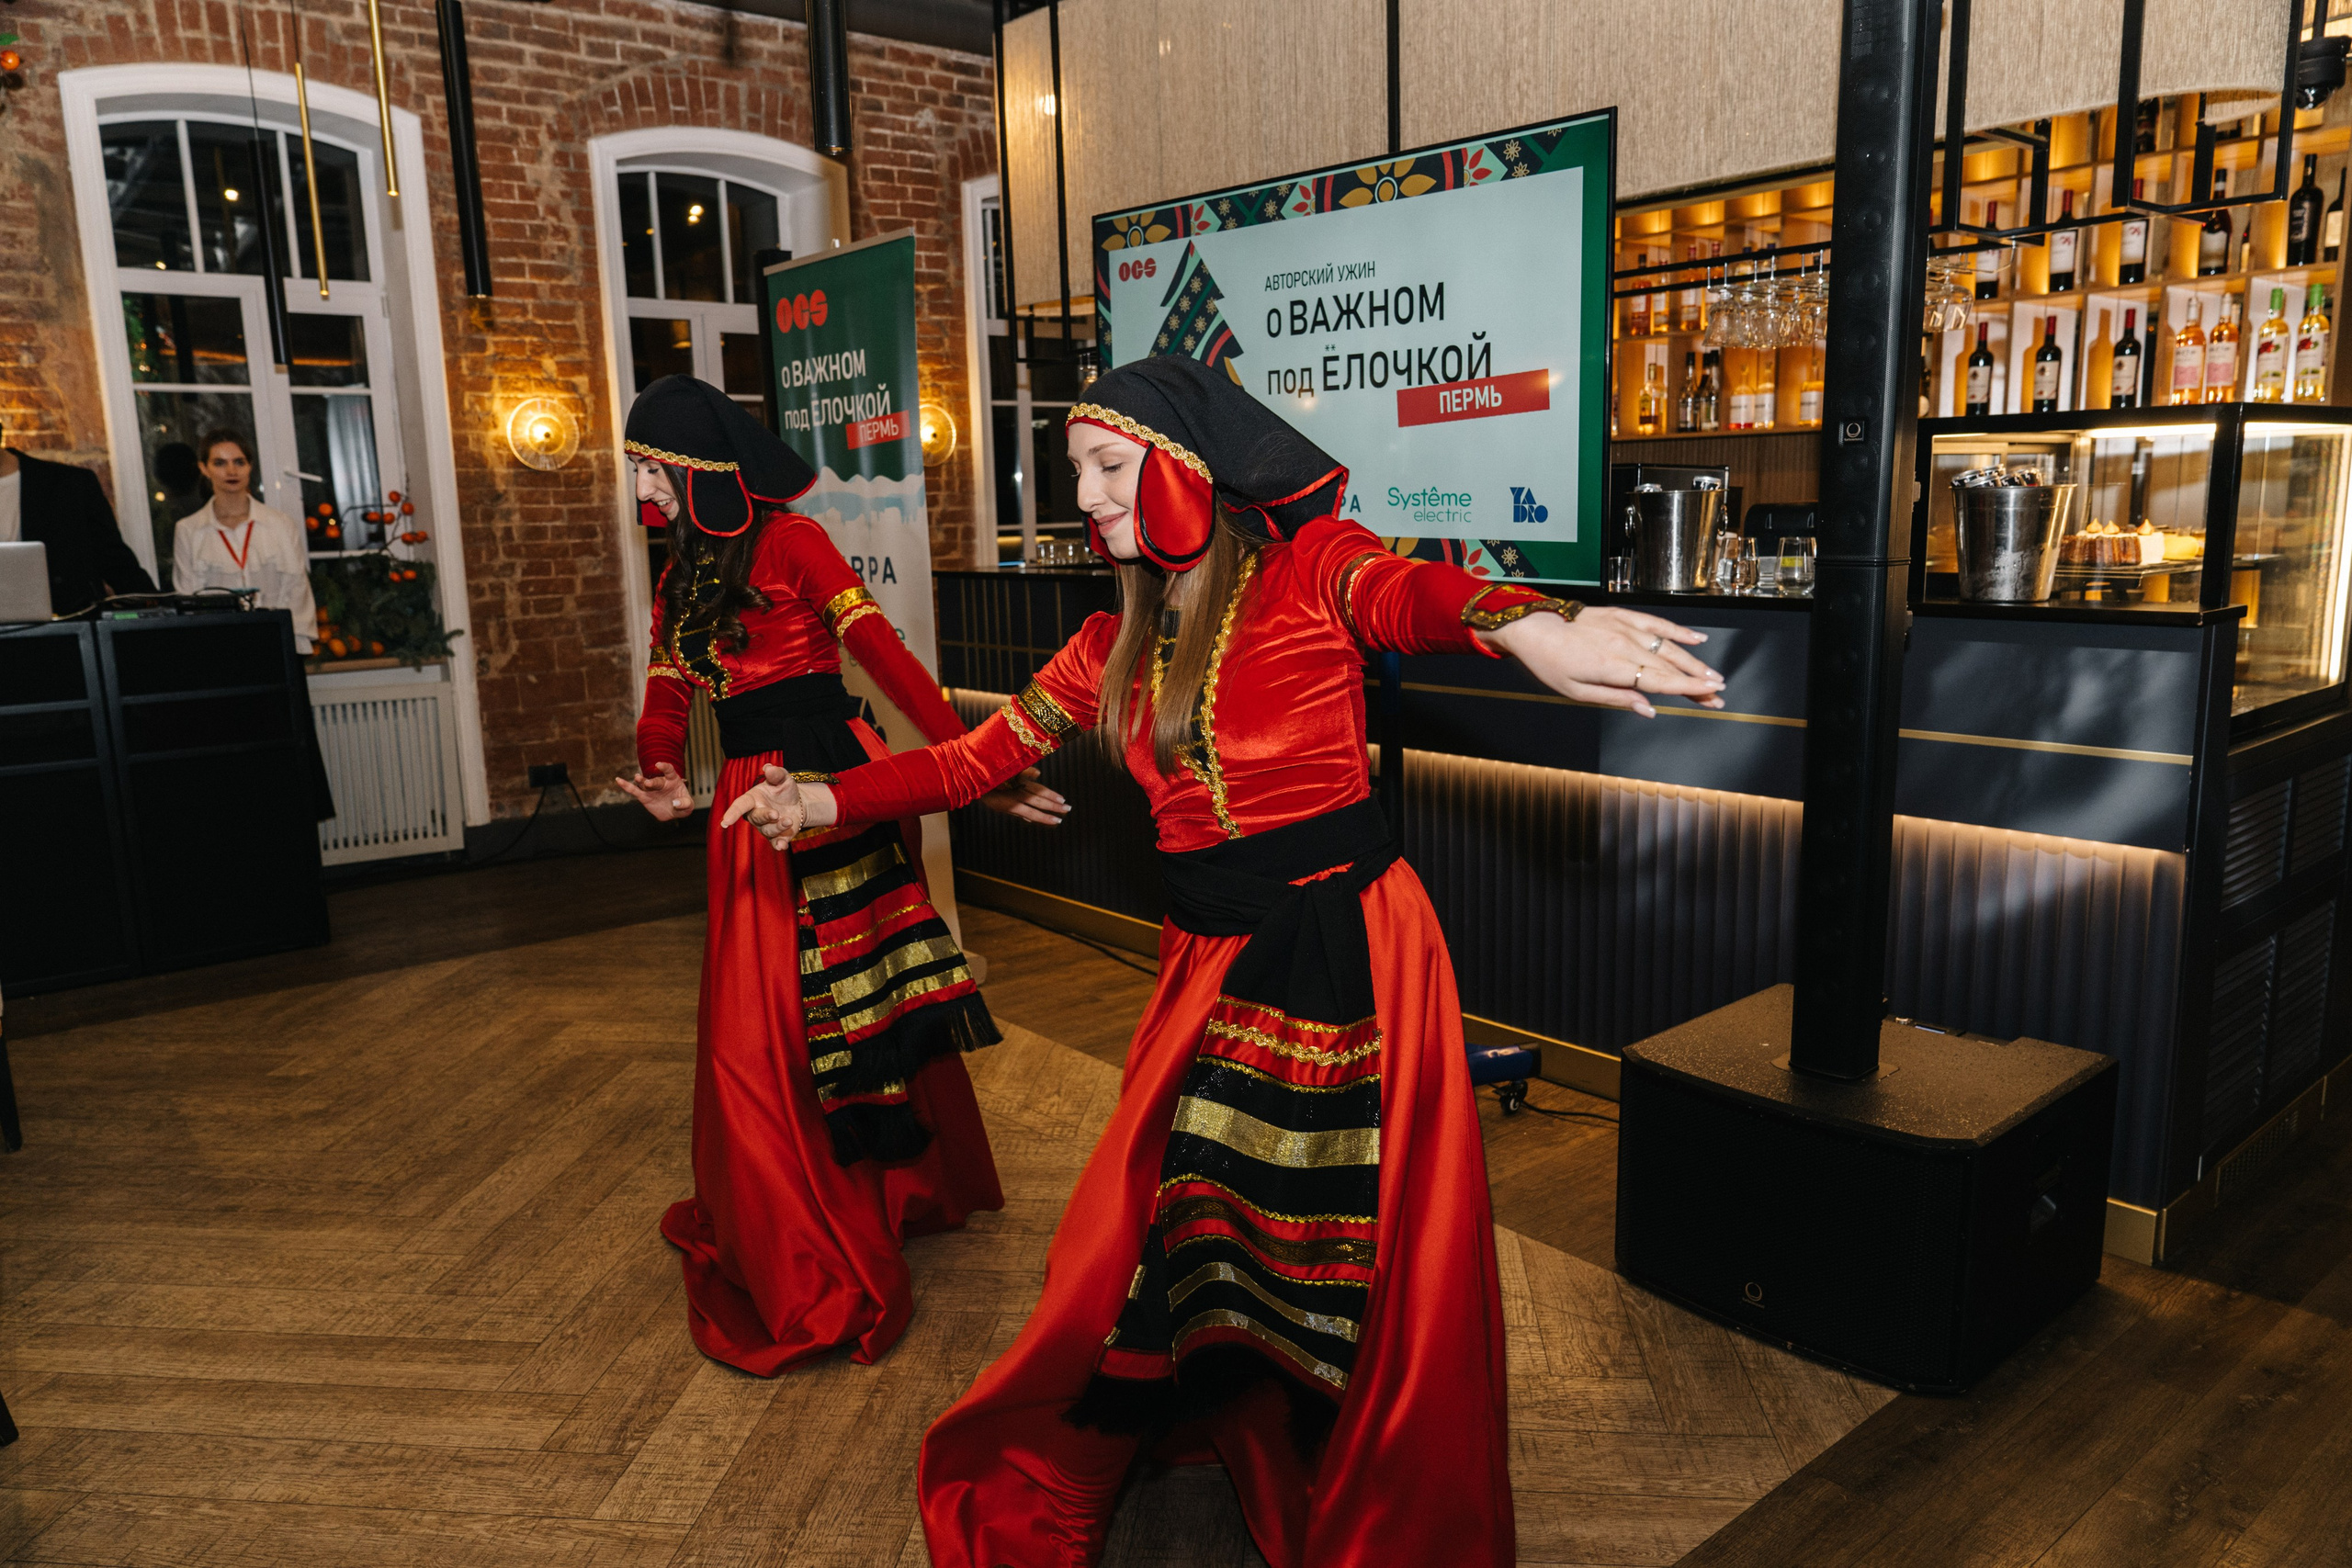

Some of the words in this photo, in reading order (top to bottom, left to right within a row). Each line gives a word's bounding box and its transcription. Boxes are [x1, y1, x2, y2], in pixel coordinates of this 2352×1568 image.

[1118, 257, 1157, 282] OCS
[1264, 263, 1333, 292] АВТОРСКИЙ
[1337, 260, 1376, 282] УЖИН
[775, 288, 829, 334] OCS
[1289, 281, 1445, 337] ВАЖНОМ
[791, 348, 866, 388] ВАЖНОМ
[1267, 367, 1315, 399] под
[1322, 331, 1492, 392] ЁЛОЧКОЙ
[785, 408, 811, 433] под
[810, 382, 892, 428] ЁЛОЧКОЙ
[1439, 384, 1503, 414] ПЕРМЬ
[857, 417, 900, 444] ПЕРМЬ
[1386, 486, 1473, 512] Systême
[1413, 507, 1473, 524] electric
[842, 556, 898, 585] RPA
